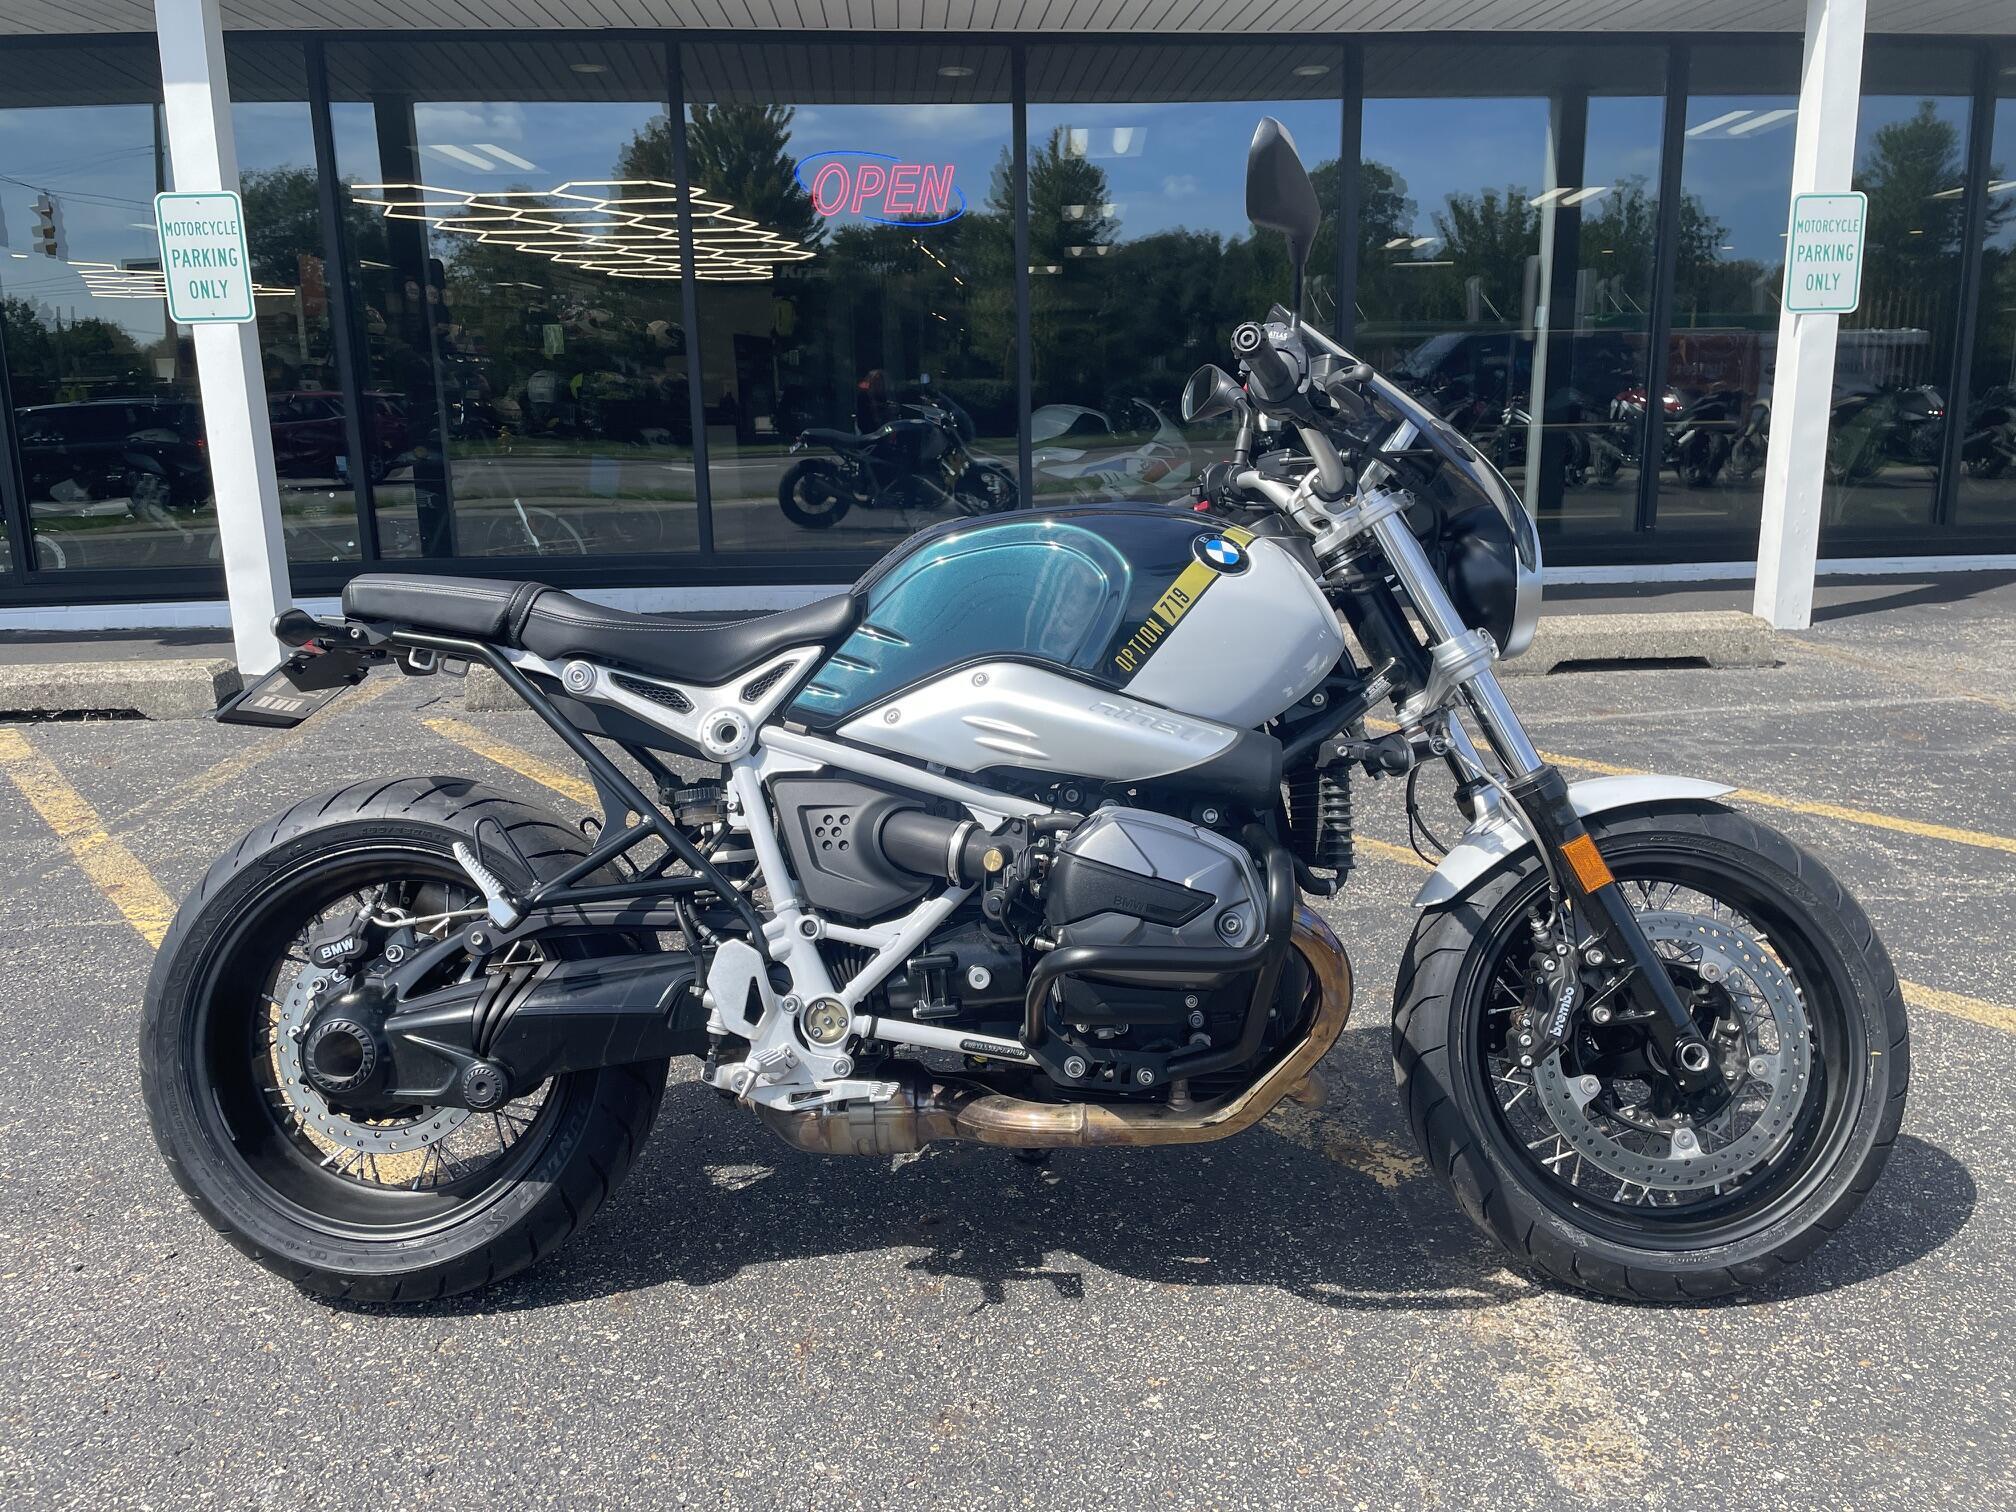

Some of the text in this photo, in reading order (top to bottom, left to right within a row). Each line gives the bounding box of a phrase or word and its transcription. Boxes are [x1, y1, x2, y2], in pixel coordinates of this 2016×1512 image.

[812, 162, 955, 216] OPEN
[165, 220, 238, 236] MOTORCYCLE
[1796, 219, 1859, 233] MOTORCYCLE
[172, 247, 238, 268] PARKING
[1797, 244, 1854, 262] PARKING
[189, 279, 228, 300] ONLY
[1805, 273, 1840, 291] ONLY
[1115, 587, 1190, 672] OPTION 719
[320, 937, 355, 959] BMW
[1549, 986, 1575, 1037] brembo
